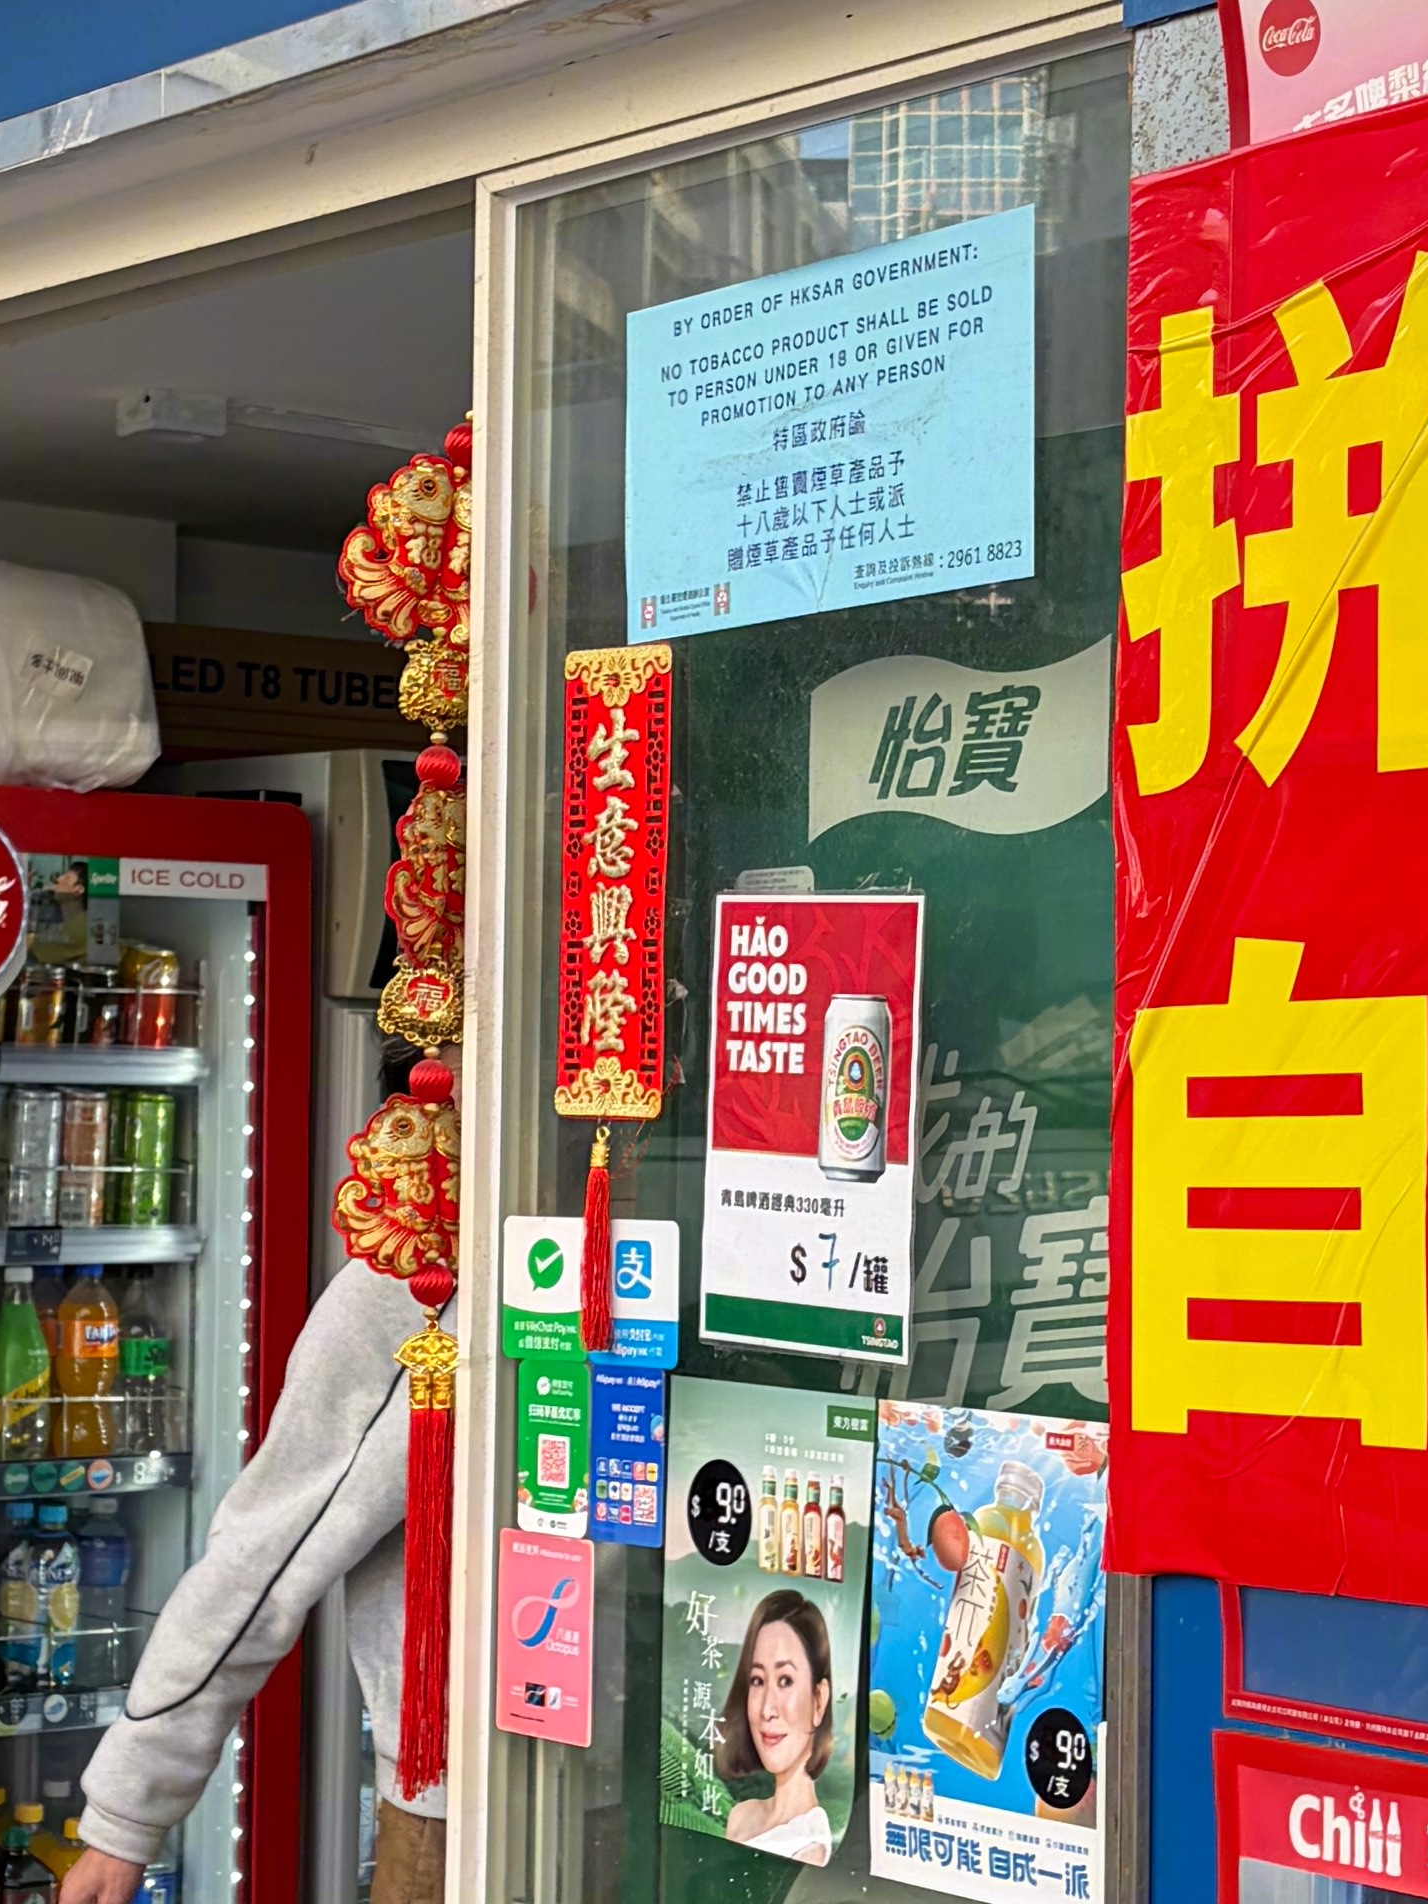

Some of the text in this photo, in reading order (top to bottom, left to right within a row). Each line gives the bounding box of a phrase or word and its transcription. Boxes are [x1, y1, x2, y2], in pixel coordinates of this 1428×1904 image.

[673, 242, 980, 337] BY ORDER OF HKSAR GOVERNMENT:
[660, 284, 994, 383] NO TOBACCO PRODUCT SHALL BE SOLD
[667, 315, 985, 408] TO PERSON UNDER 18 OR GIVEN FOR
[700, 354, 946, 427] PROMOTION TO ANY PERSON
[772, 408, 866, 453] 特區政府諭
[986, 539, 1022, 562] 8823
[154, 654, 224, 696] LED
[239, 663, 283, 701] T8
[867, 685, 1043, 802] 怡寶
[130, 867, 171, 887] ICE
[178, 870, 245, 890] COLD
[726, 962, 808, 997] GOOD
[726, 1000, 808, 1036] TIMES
[725, 1039, 806, 1076] TASTE
[789, 1242, 808, 1286] $
[818, 1232, 841, 1292] 7
[885, 1821, 983, 1876] 無限可能
[988, 1846, 1091, 1900] 自成一派
[1288, 1785, 1403, 1877] Chill
